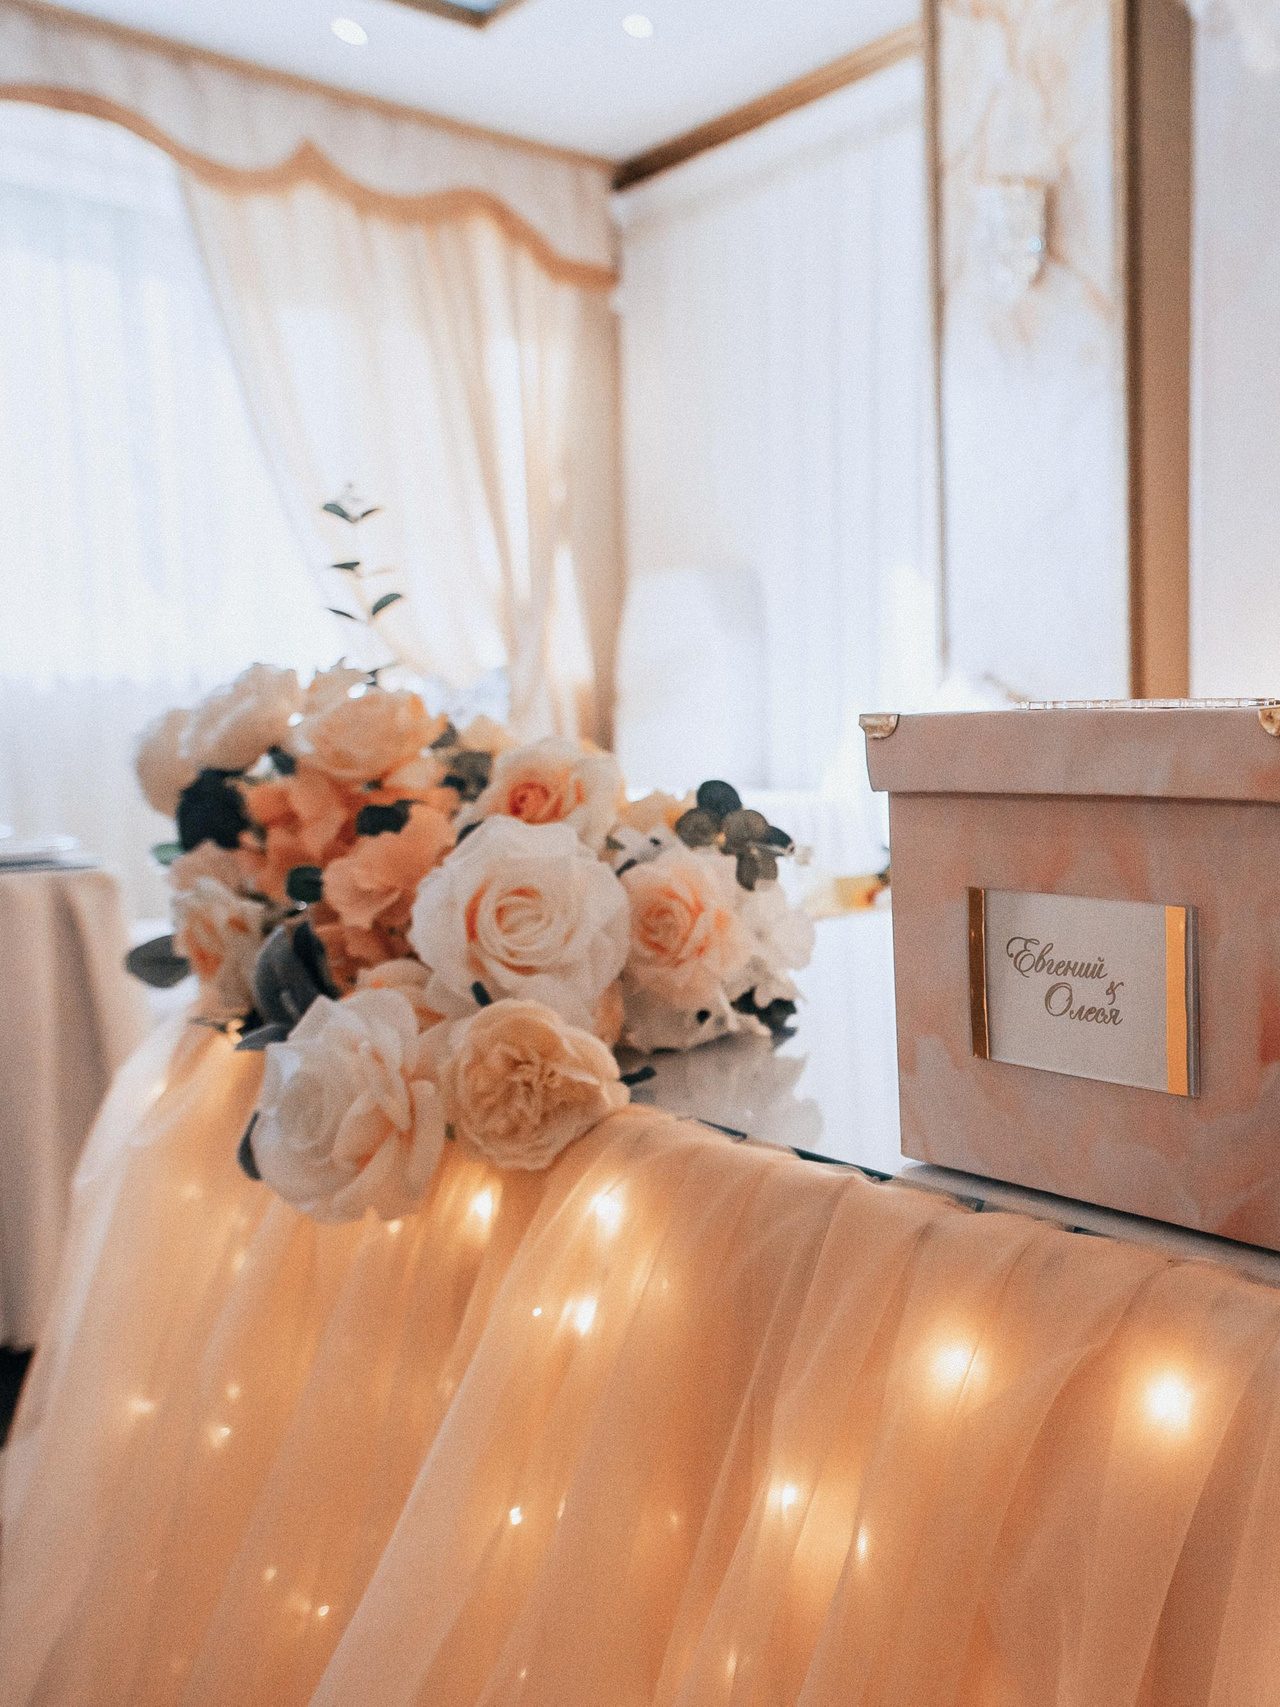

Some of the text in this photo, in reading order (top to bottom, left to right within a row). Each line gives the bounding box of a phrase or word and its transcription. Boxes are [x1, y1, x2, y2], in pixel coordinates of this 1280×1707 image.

[1006, 936, 1108, 979] Евгений
[1044, 981, 1124, 1026] Олеся
[1105, 980, 1125, 1006] &
